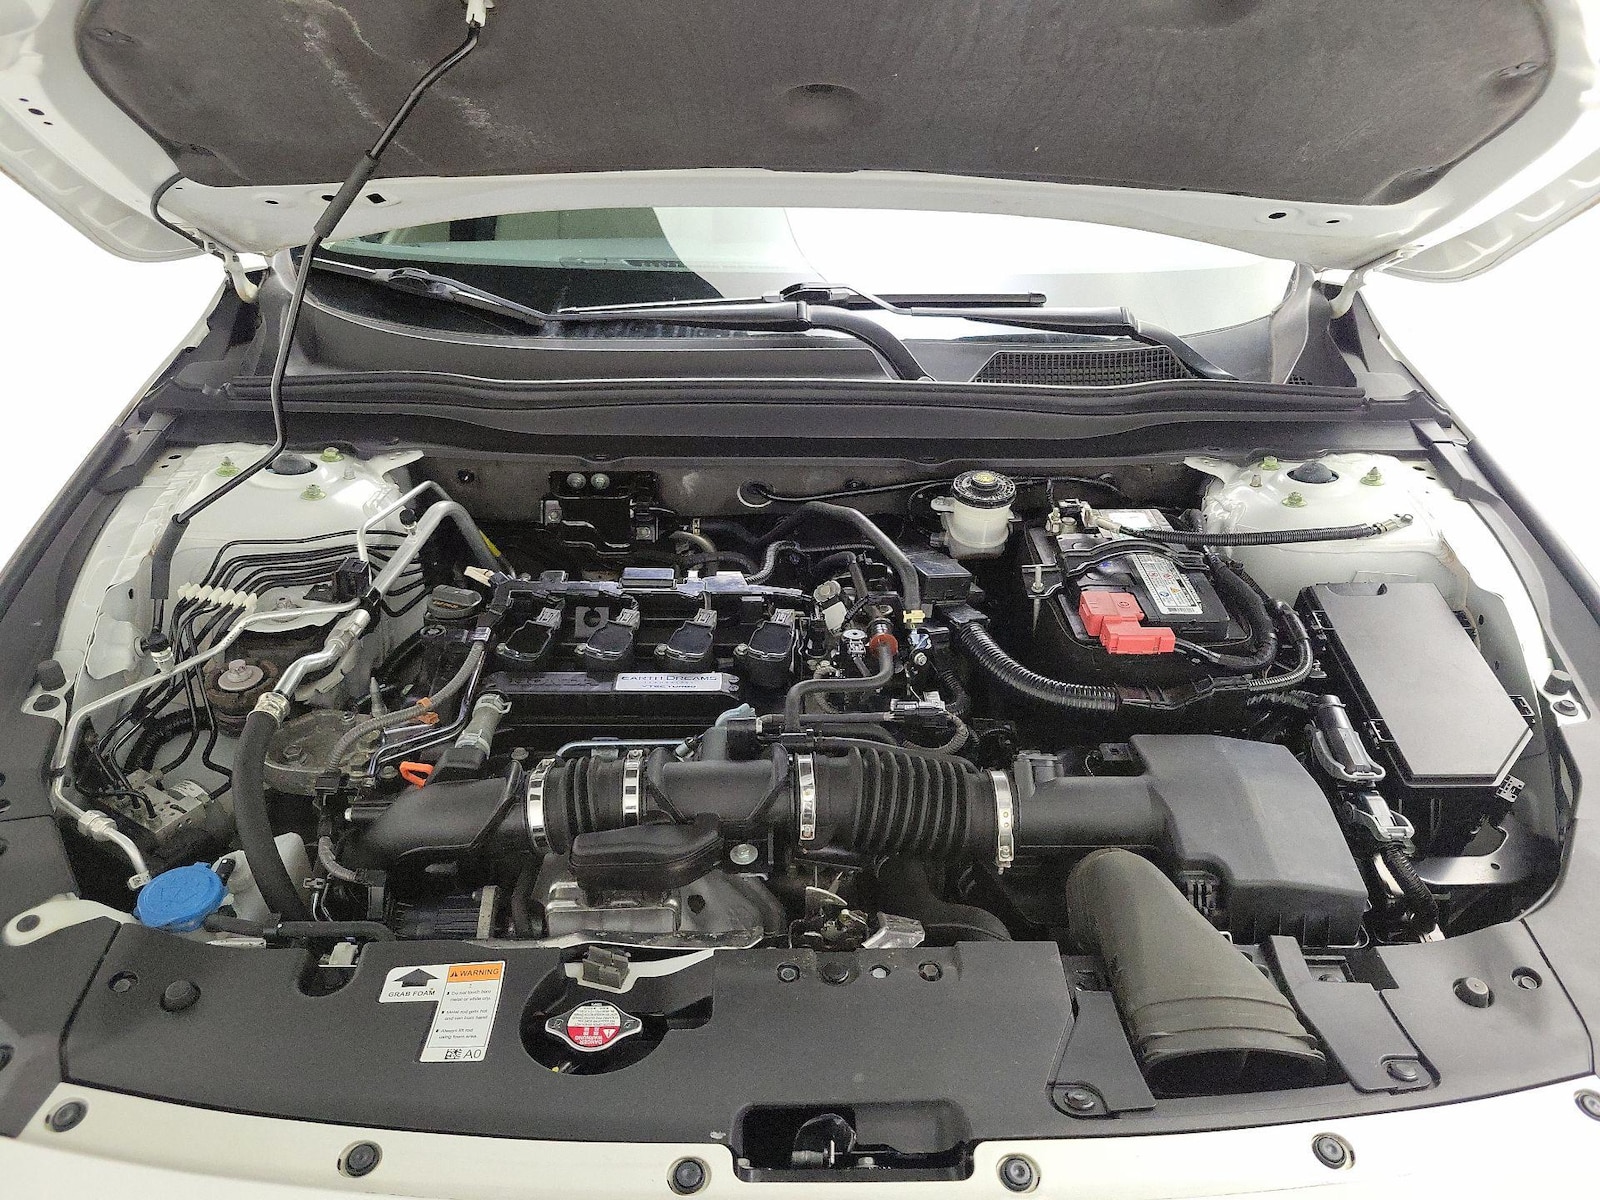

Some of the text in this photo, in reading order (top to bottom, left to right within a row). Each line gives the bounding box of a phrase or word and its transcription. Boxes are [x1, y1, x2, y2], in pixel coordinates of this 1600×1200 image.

[459, 968, 499, 977] WARNING
[412, 989, 436, 997] FOAM
[463, 1049, 482, 1059] A0
